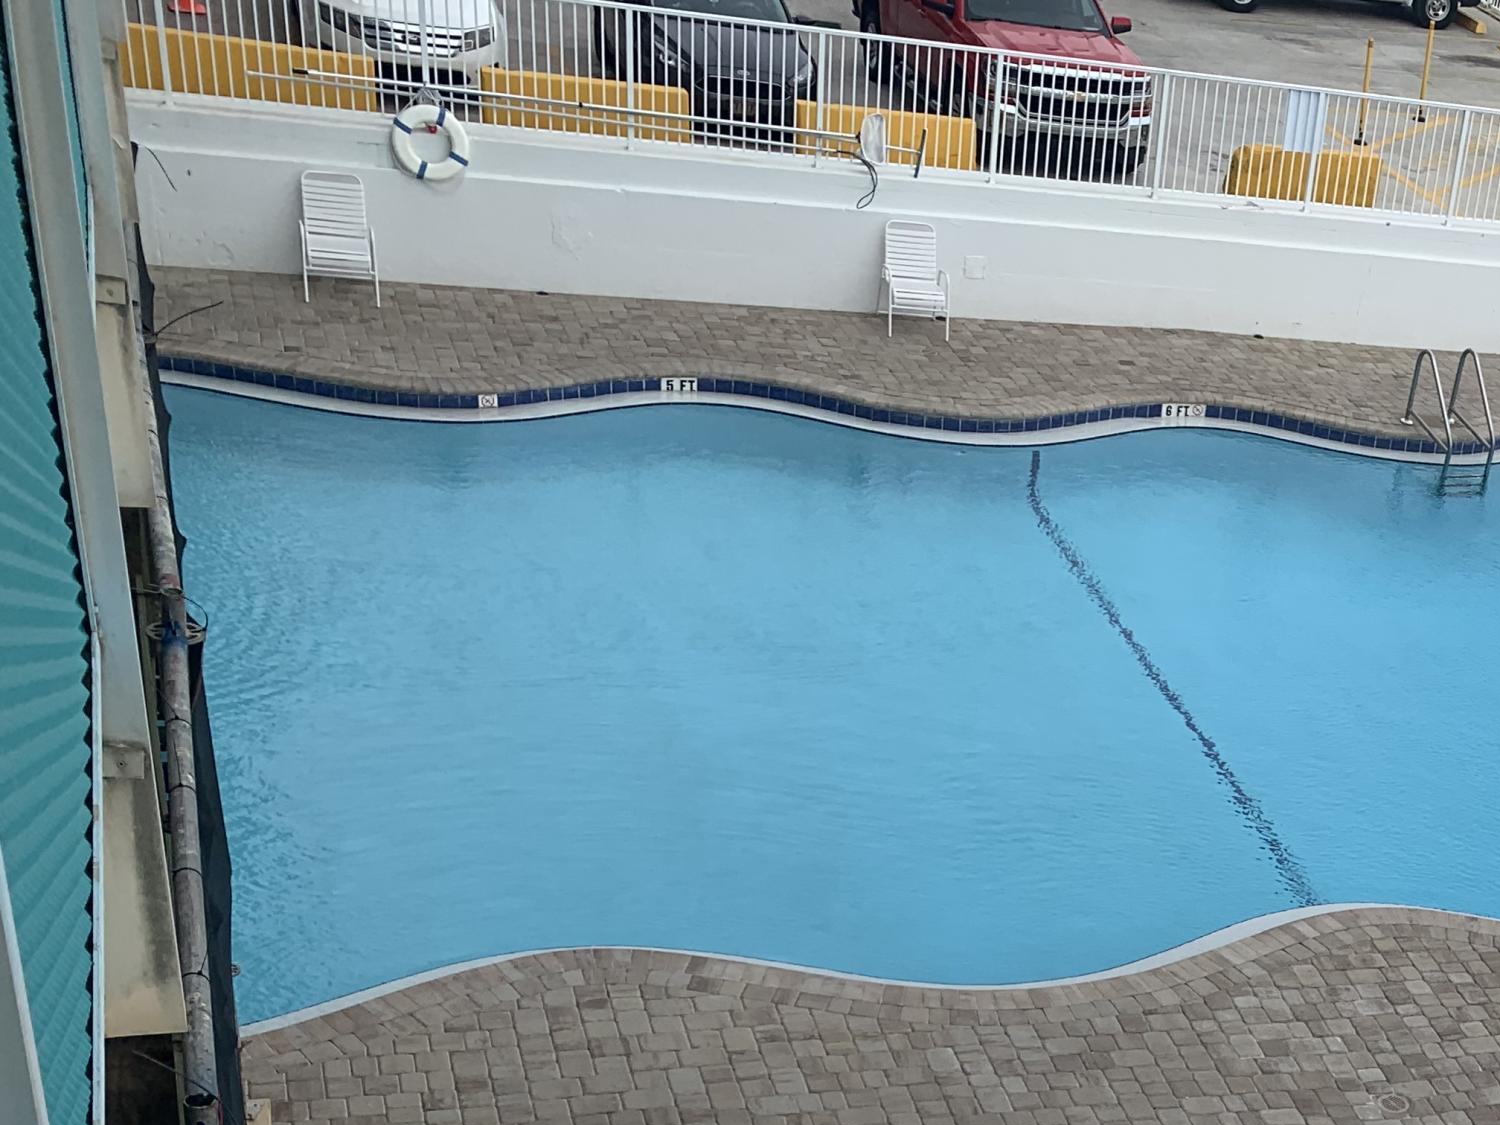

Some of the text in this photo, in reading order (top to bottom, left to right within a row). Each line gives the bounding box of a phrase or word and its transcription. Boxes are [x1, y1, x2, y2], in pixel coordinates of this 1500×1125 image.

[666, 379, 696, 391] 5 FT
[1166, 404, 1190, 417] 6 FT
